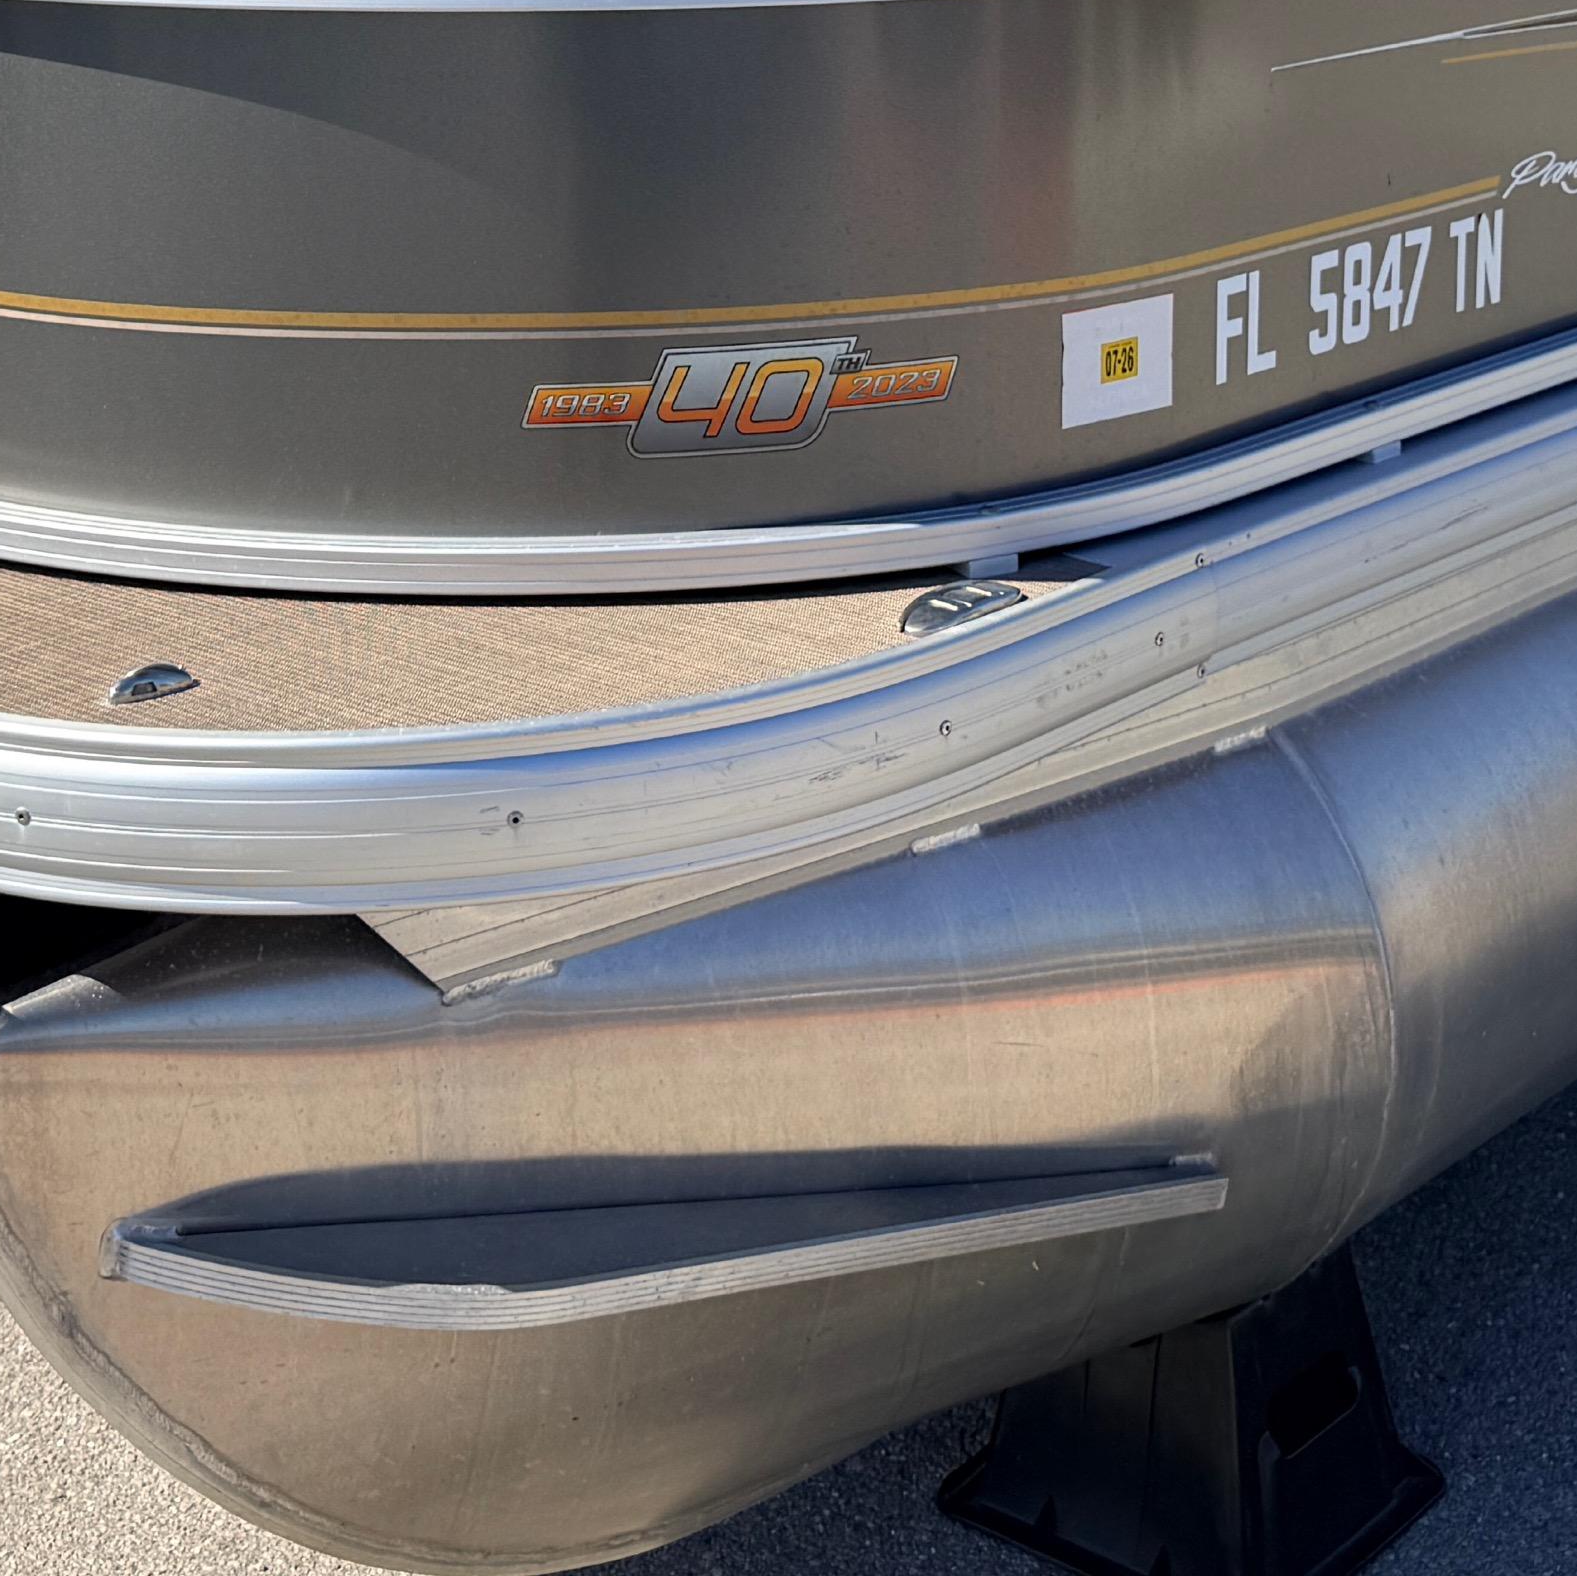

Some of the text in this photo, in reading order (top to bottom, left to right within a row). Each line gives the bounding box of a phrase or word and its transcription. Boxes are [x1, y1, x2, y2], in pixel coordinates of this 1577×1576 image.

[1216, 208, 1504, 385] FL 5847 TN
[1105, 346, 1134, 377] 07-26
[540, 390, 631, 418] 1983
[846, 367, 942, 401] 2023
